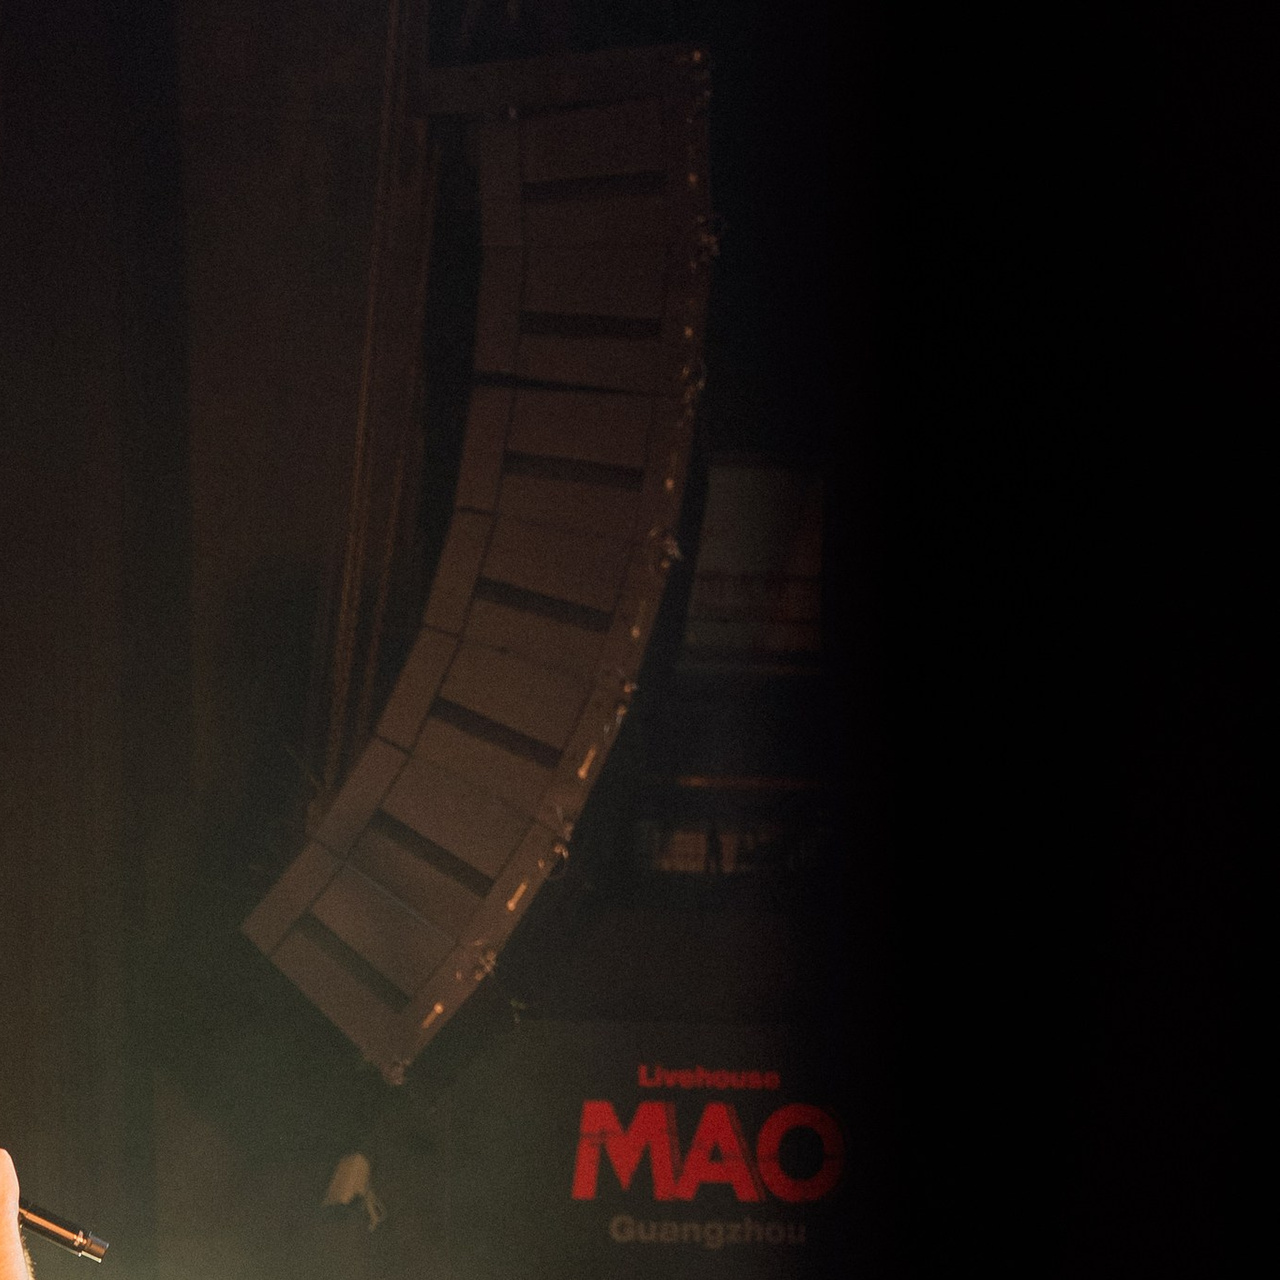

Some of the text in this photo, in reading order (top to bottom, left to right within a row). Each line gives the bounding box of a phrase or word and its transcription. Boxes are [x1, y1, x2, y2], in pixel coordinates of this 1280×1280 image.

[637, 1064, 780, 1089] Livehouse
[572, 1099, 845, 1204] MAO
[609, 1213, 807, 1249] Guangzhou
